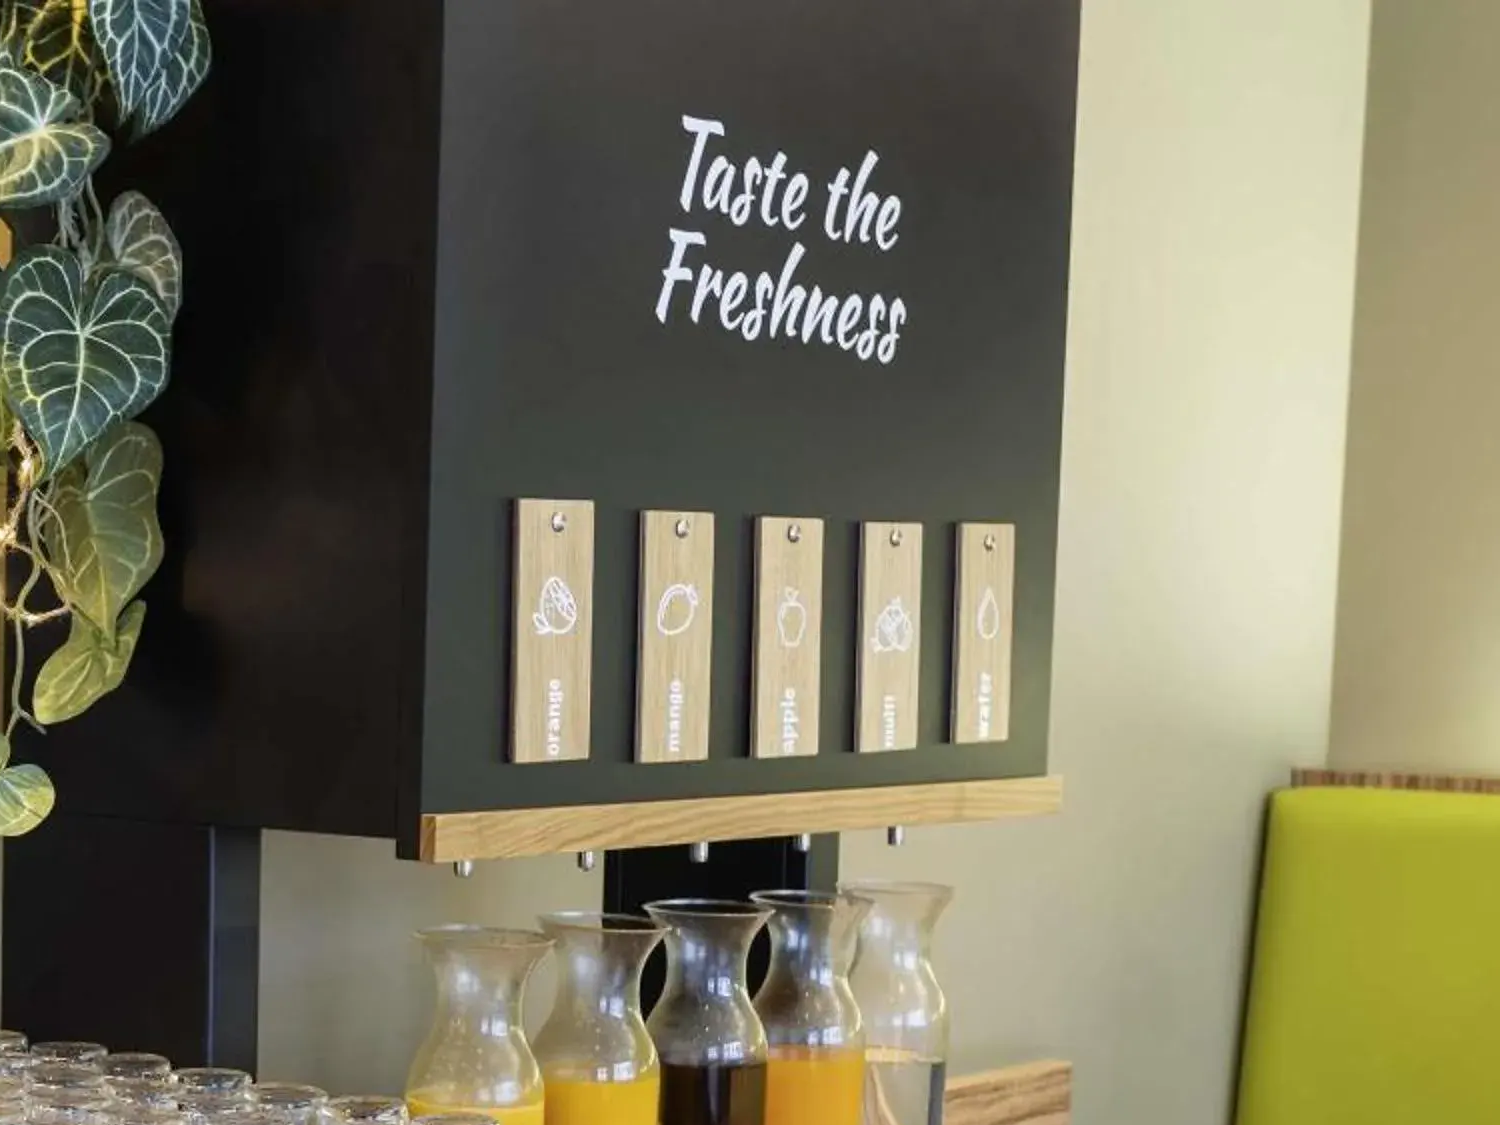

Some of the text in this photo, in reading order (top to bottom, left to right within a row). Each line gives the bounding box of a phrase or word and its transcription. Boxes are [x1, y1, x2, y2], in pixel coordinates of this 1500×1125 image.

[679, 114, 902, 251] Taste the
[655, 227, 908, 365] Freshness
[547, 678, 564, 756] orange
[668, 679, 684, 752] mango
[780, 687, 798, 754] apple
